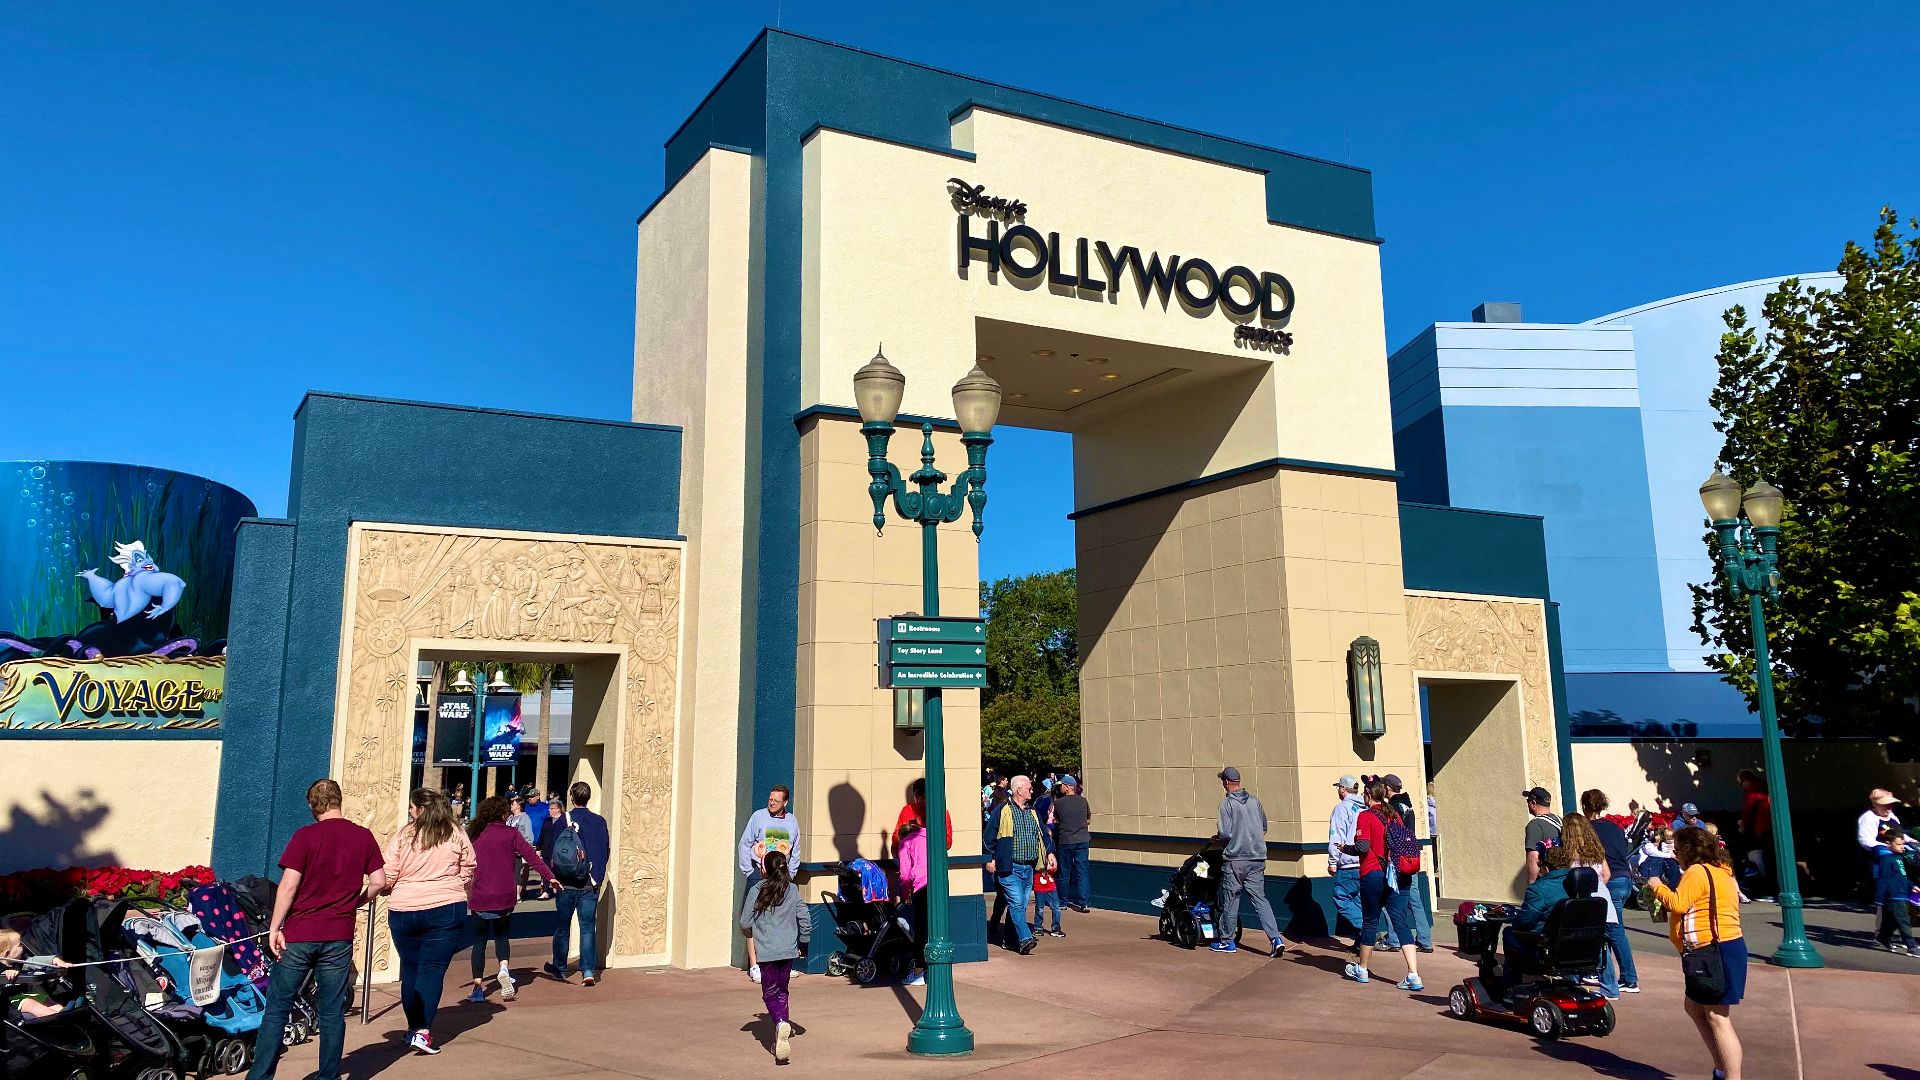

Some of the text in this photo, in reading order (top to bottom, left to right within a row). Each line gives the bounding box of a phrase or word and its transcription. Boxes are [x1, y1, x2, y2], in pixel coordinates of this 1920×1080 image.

[957, 214, 1295, 321] HOLLYWOOD
[897, 647, 909, 655] Toy
[910, 647, 927, 655] Story
[908, 671, 938, 679] Incredible
[33, 670, 204, 721] VOYAGE
[438, 702, 470, 710] STAR
[438, 711, 470, 719] WARS
[488, 743, 515, 751] STAR
